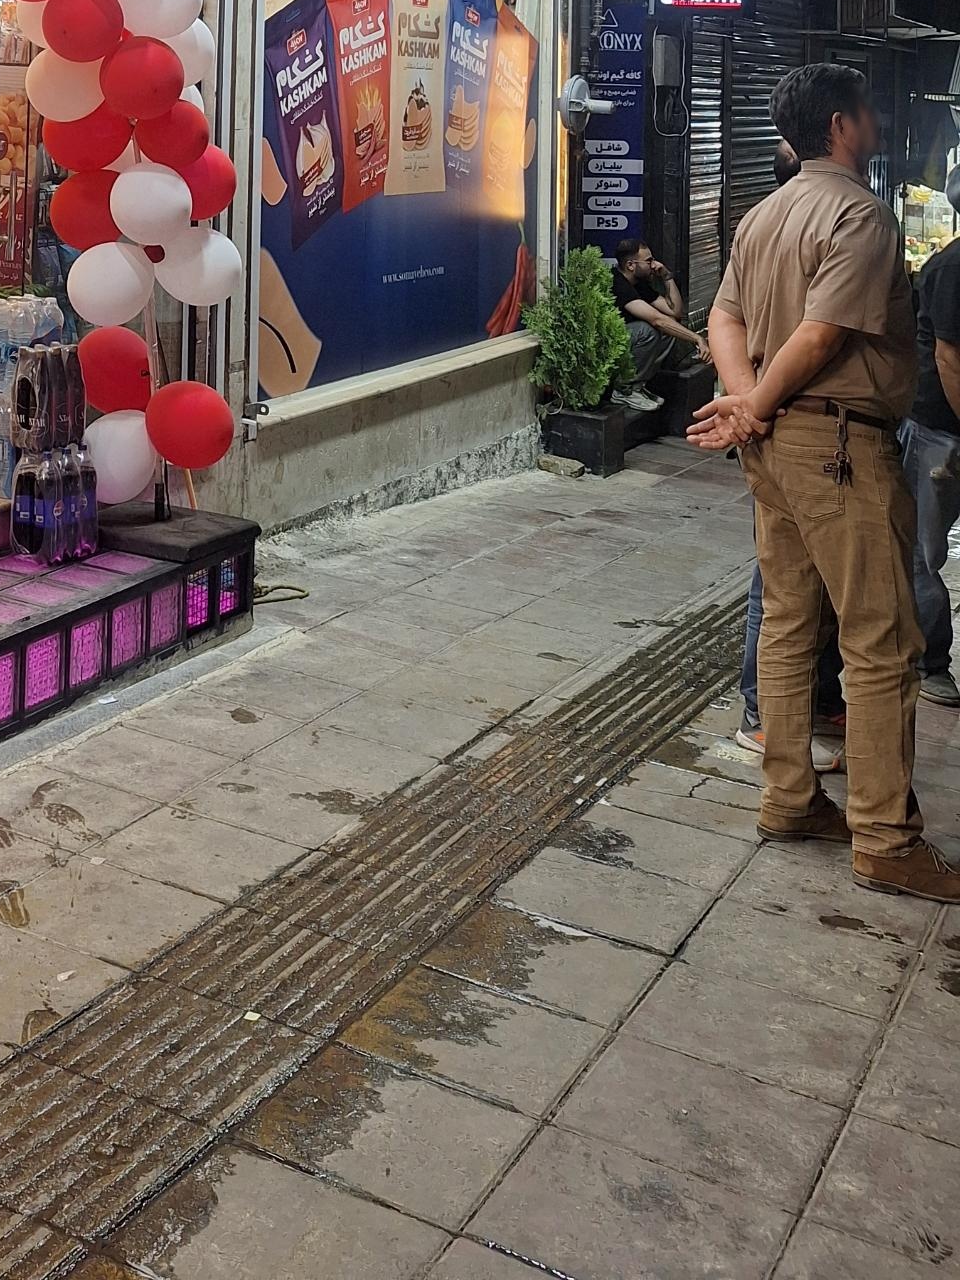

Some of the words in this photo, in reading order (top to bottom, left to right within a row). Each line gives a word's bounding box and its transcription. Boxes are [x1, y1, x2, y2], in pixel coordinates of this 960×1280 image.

[339, 11, 386, 55] کشکام
[398, 12, 441, 40] کشکام
[397, 39, 440, 60] KASHKAM
[452, 21, 489, 60] کشکام
[600, 30, 642, 50] ONYX
[341, 40, 387, 75] KASHKAM
[450, 45, 487, 78] KASHKAM
[276, 39, 325, 98] کشکام
[610, 69, 625, 82] گیم
[625, 69, 642, 80] کافه
[279, 67, 328, 117] KASHKAM
[595, 142, 622, 153] شافل
[595, 161, 623, 172] بیلیارد
[595, 179, 622, 190] اسنوکر
[595, 198, 621, 209] مافیا
[596, 216, 619, 228] Ps5
